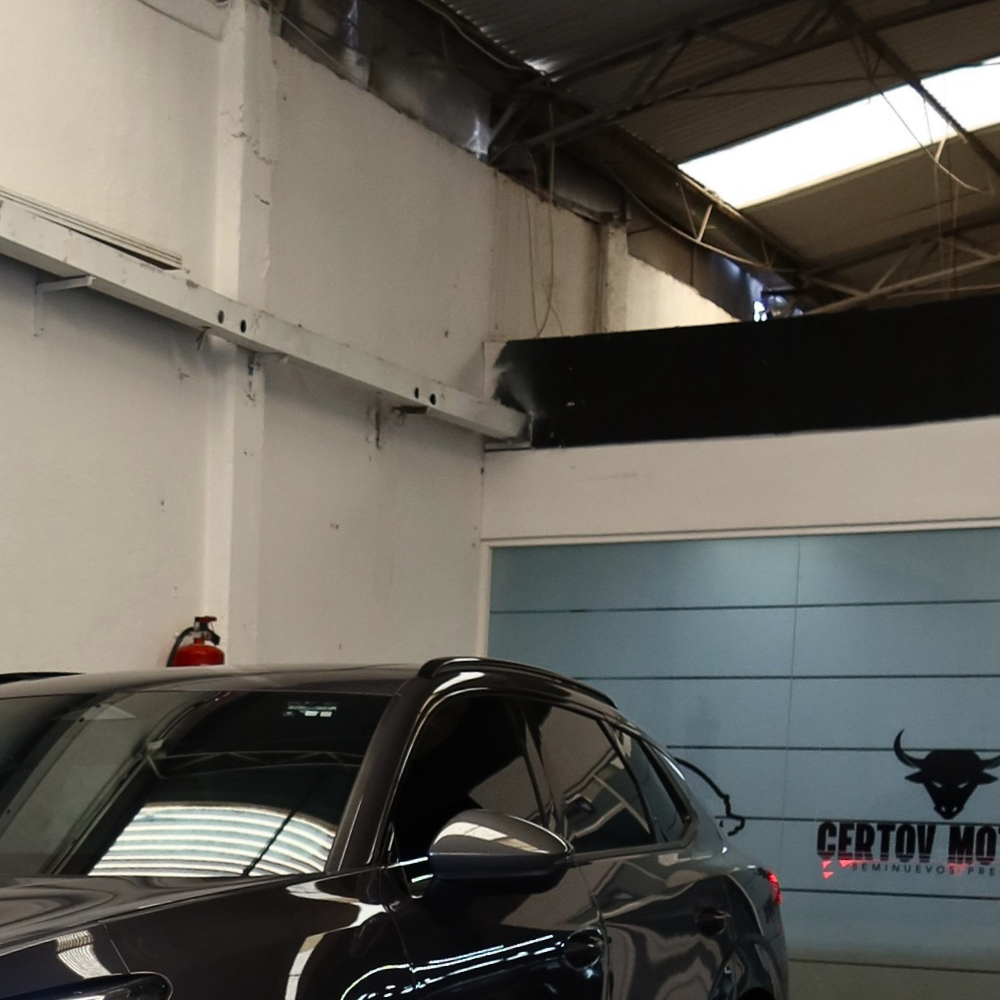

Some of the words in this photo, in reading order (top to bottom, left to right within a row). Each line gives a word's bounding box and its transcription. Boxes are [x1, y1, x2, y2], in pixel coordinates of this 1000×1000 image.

[817, 821, 936, 863] CERTOV
[947, 824, 1000, 866] MO
[852, 863, 955, 875] SEMINUEVOS
[967, 866, 1000, 876] PRE
